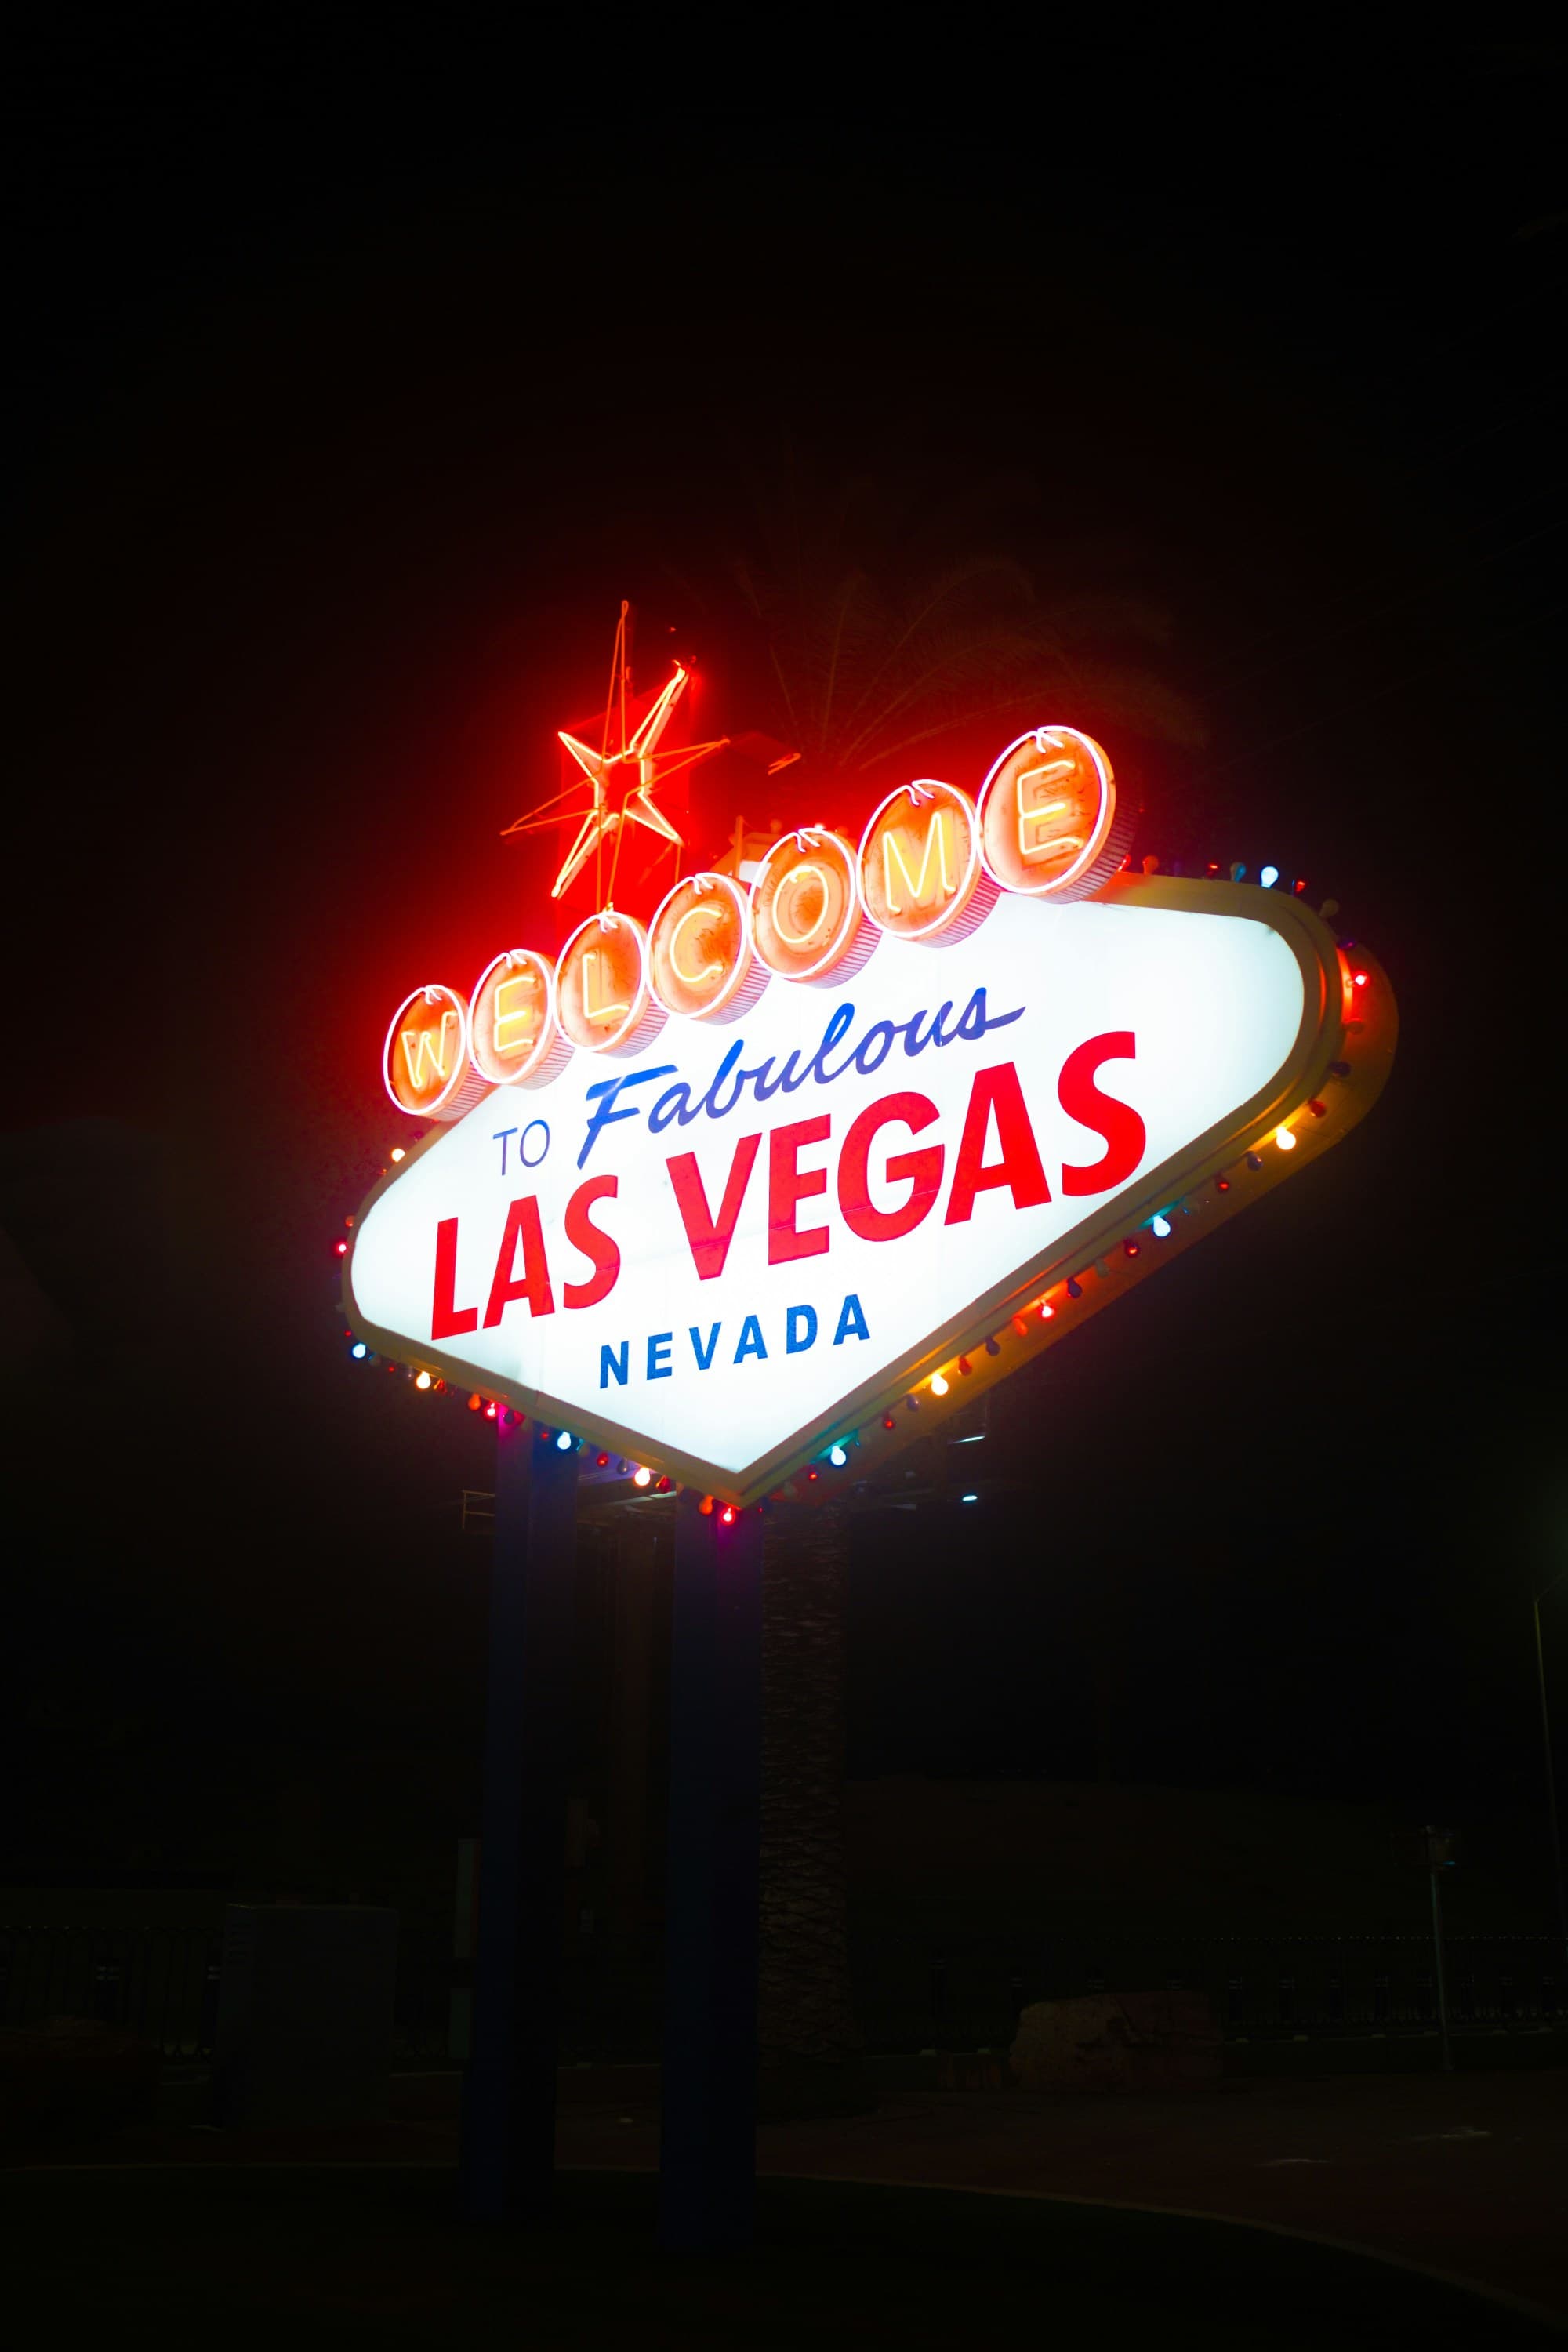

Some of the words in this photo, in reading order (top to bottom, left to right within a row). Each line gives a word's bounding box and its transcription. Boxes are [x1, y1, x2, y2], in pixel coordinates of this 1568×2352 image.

[401, 758, 1083, 1088] WELCOME
[430, 1174, 621, 1341] LAS
[665, 1031, 1146, 1281] VEGAS
[492, 1119, 551, 1176] TO
[577, 986, 1026, 1170] Fabulous
[599, 1294, 870, 1389] NEVADA
